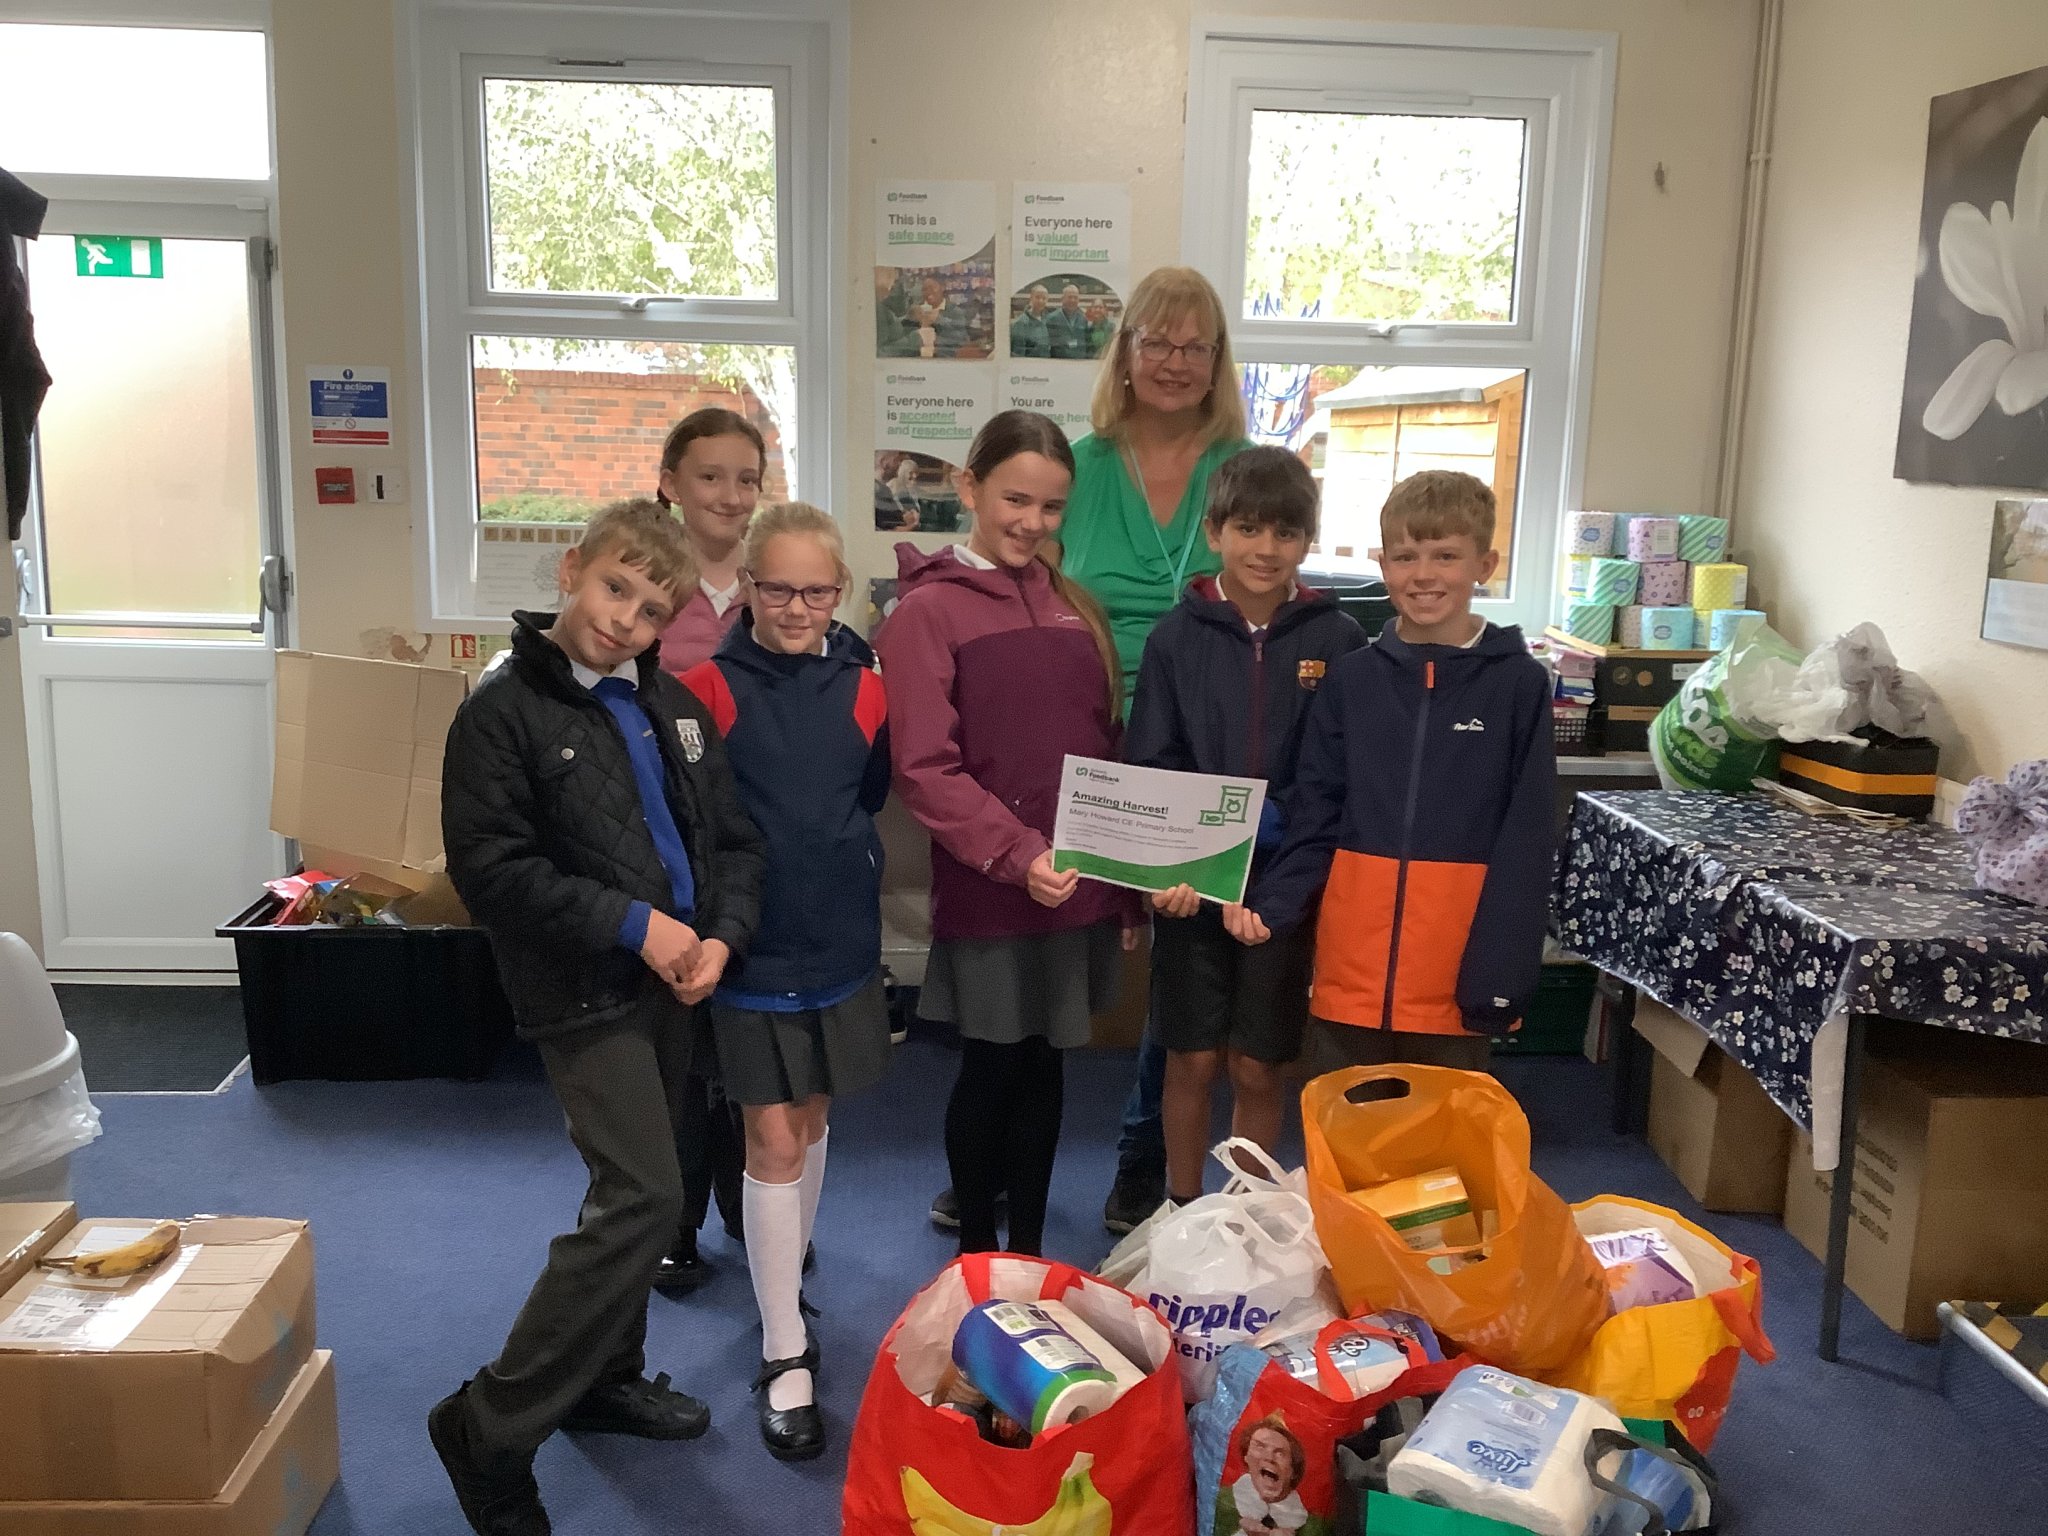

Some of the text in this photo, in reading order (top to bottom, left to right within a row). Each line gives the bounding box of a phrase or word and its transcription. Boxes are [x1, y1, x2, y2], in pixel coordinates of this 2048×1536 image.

[888, 214, 937, 225] This is a
[1025, 216, 1113, 232] Everyone here
[888, 230, 954, 244] safe space
[1024, 231, 1078, 243] is valued
[1024, 247, 1109, 261] and important
[323, 382, 374, 391] Fire action
[887, 395, 974, 409] Everyone here
[1011, 396, 1055, 407] You are
[887, 410, 956, 423] is accepted
[887, 425, 973, 438] and respected
[1072, 790, 1169, 815] Amazing Harvest!
[1069, 808, 1194, 834] Mary Howard CE Primary School
